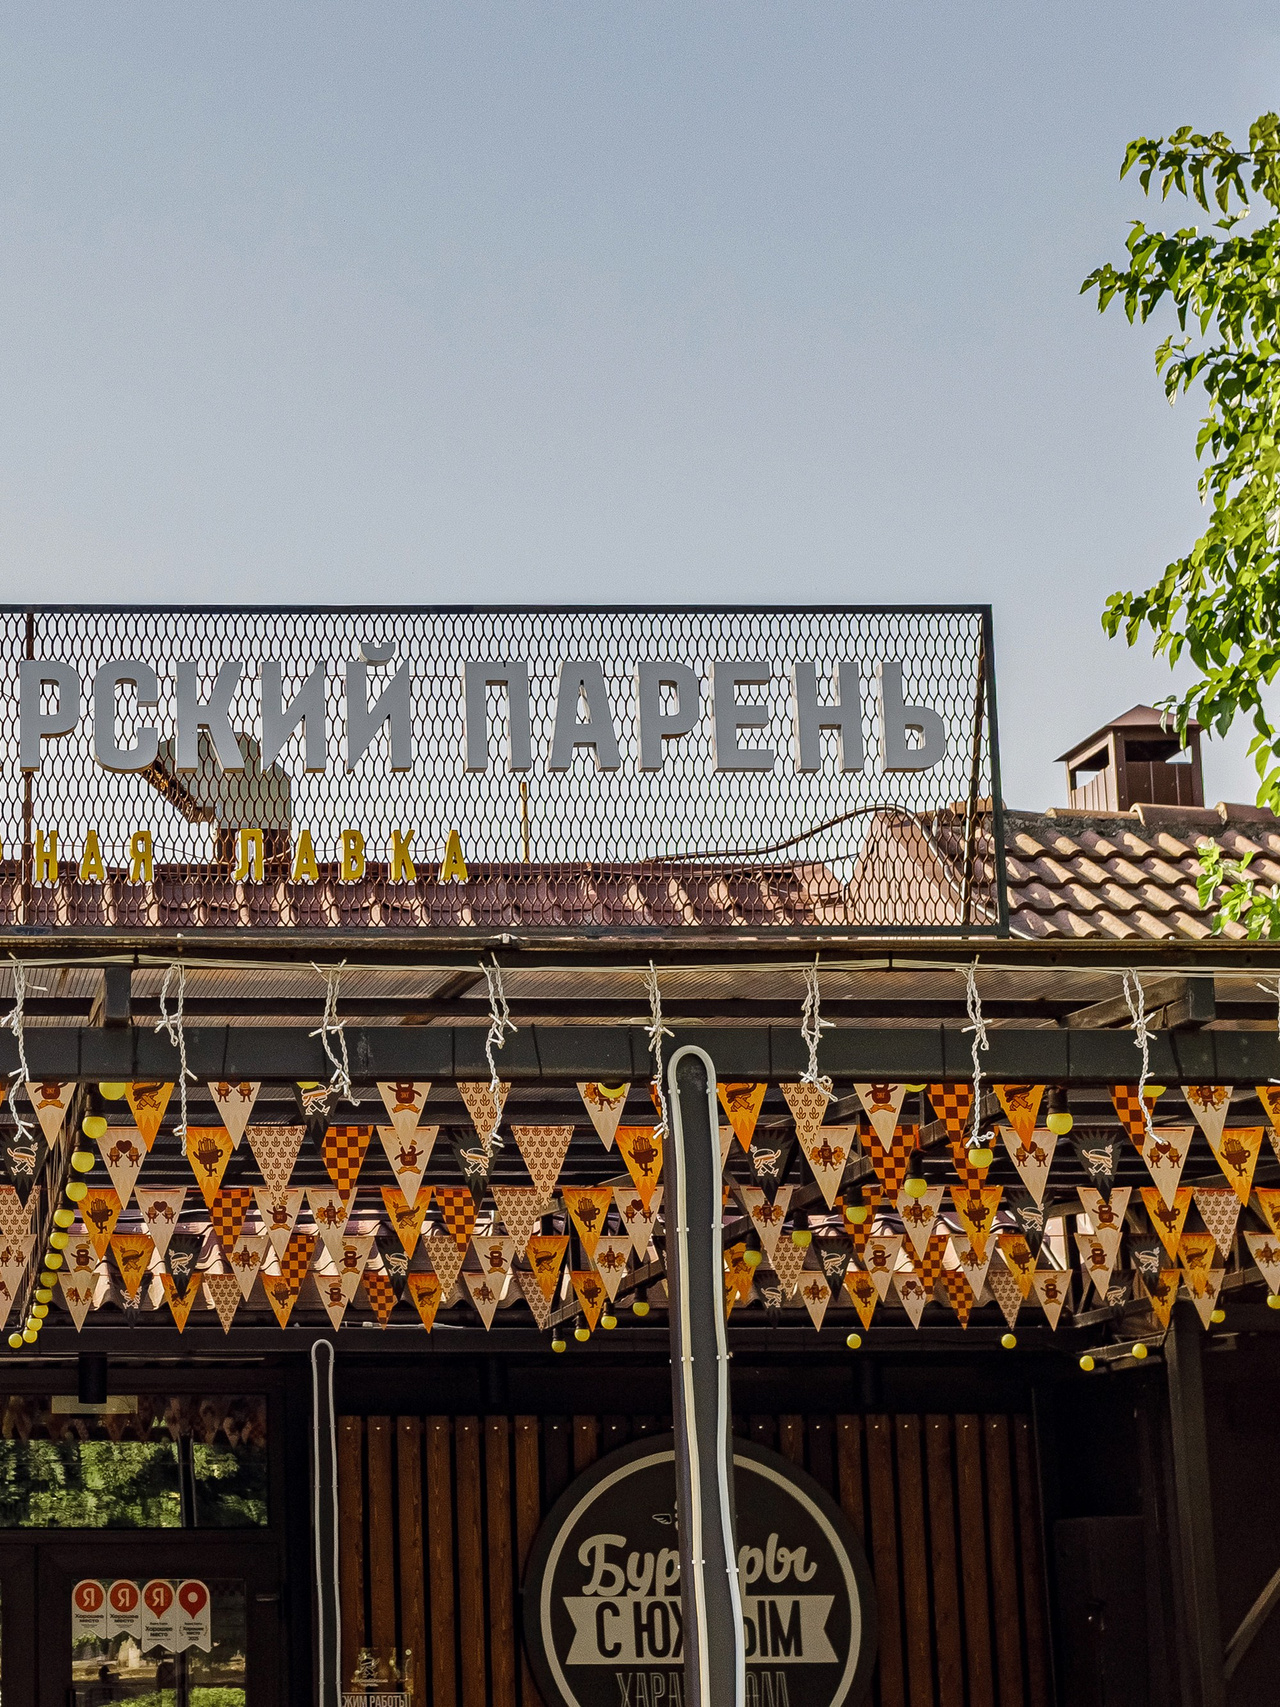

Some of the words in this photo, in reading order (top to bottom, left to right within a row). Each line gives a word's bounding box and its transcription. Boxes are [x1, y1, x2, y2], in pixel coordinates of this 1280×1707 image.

[463, 661, 947, 773] ПАРЕНЬ
[233, 829, 470, 886] ЛАВКА
[578, 1533, 817, 1600] Бурры
[82, 1587, 95, 1607] Я
[117, 1587, 130, 1607] Я
[152, 1587, 164, 1607] Я
[595, 1601, 622, 1659] С
[634, 1600, 803, 1659] ЮЫМ
[342, 1695, 368, 1707] ЖИМ
